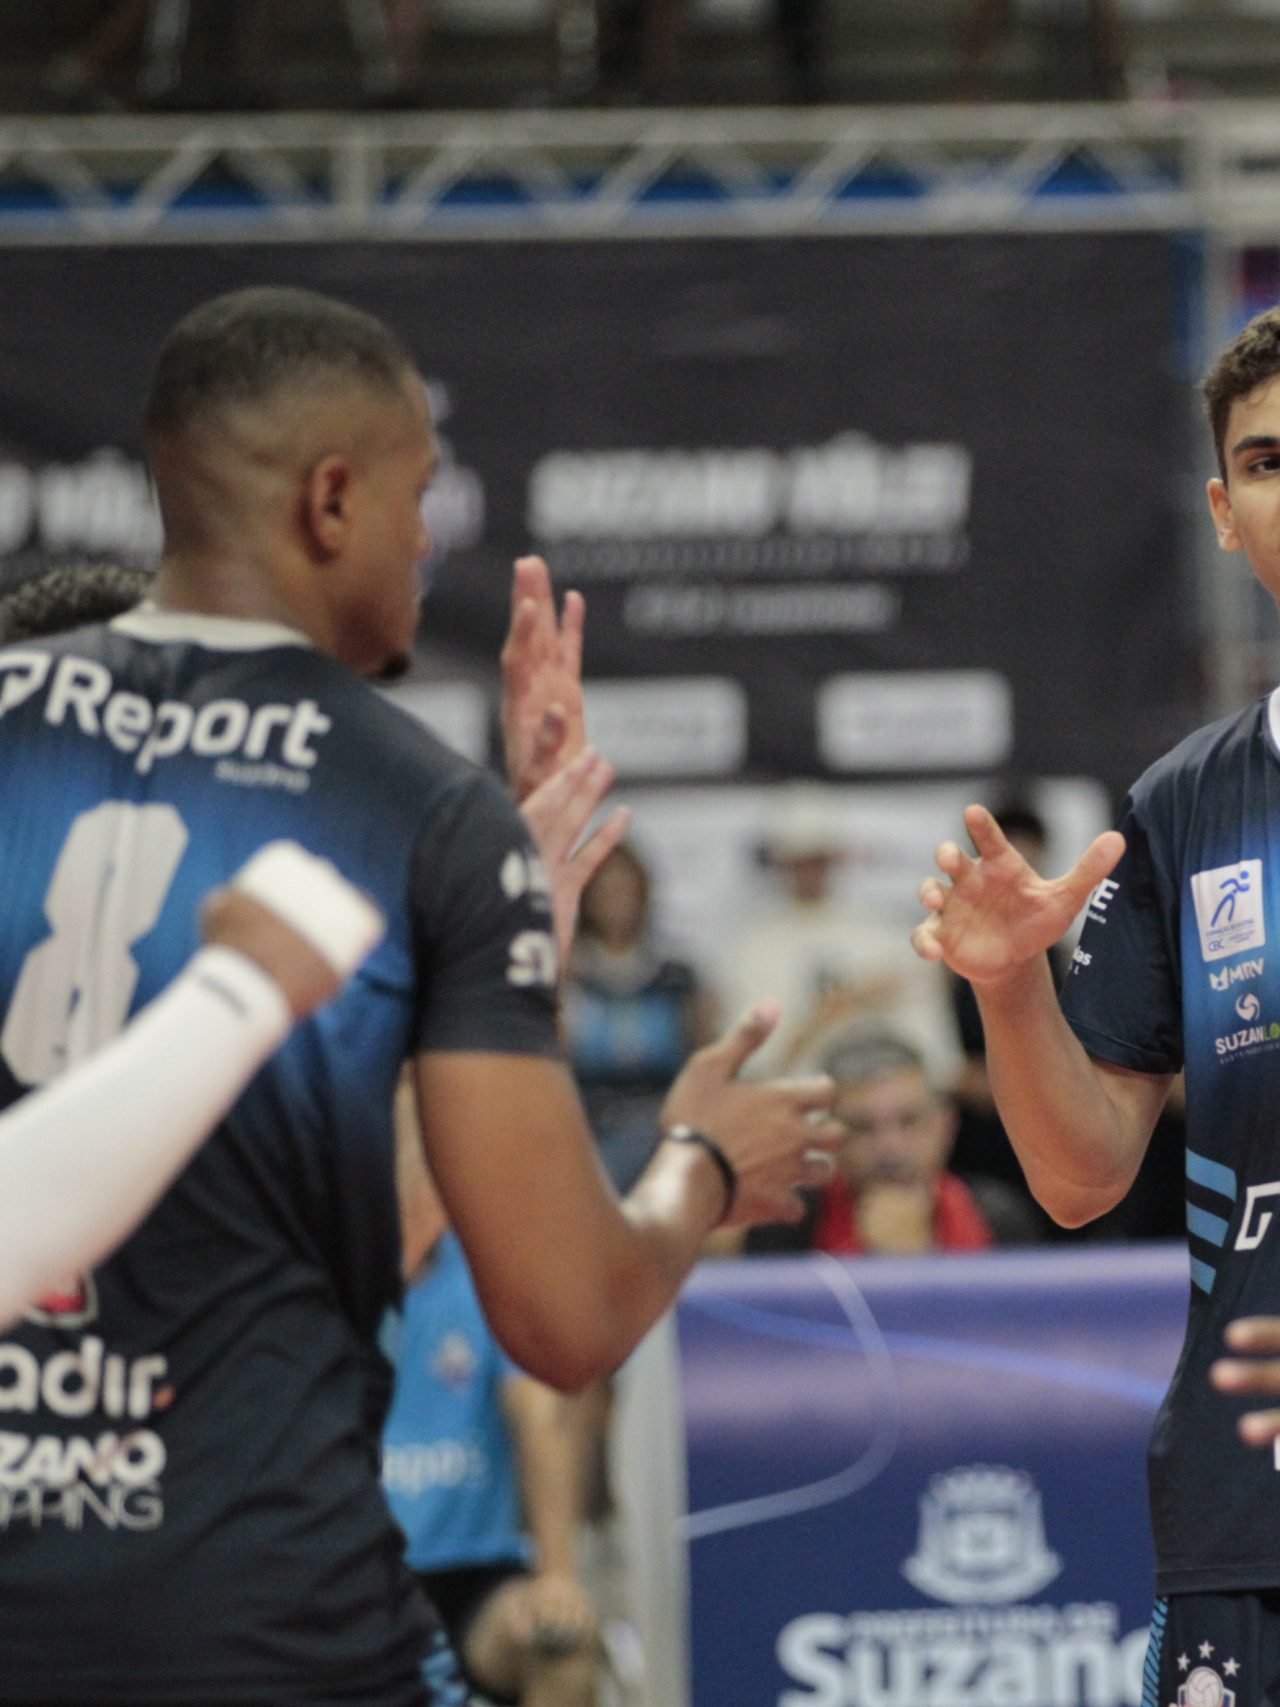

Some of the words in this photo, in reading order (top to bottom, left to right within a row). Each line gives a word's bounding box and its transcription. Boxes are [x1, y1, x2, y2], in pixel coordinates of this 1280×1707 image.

[45, 654, 331, 774] Report
[0, 800, 189, 1087] 8
[1228, 958, 1265, 984] MRV
[0, 1335, 176, 1420] adir.
[0, 1429, 168, 1488] ZANO
